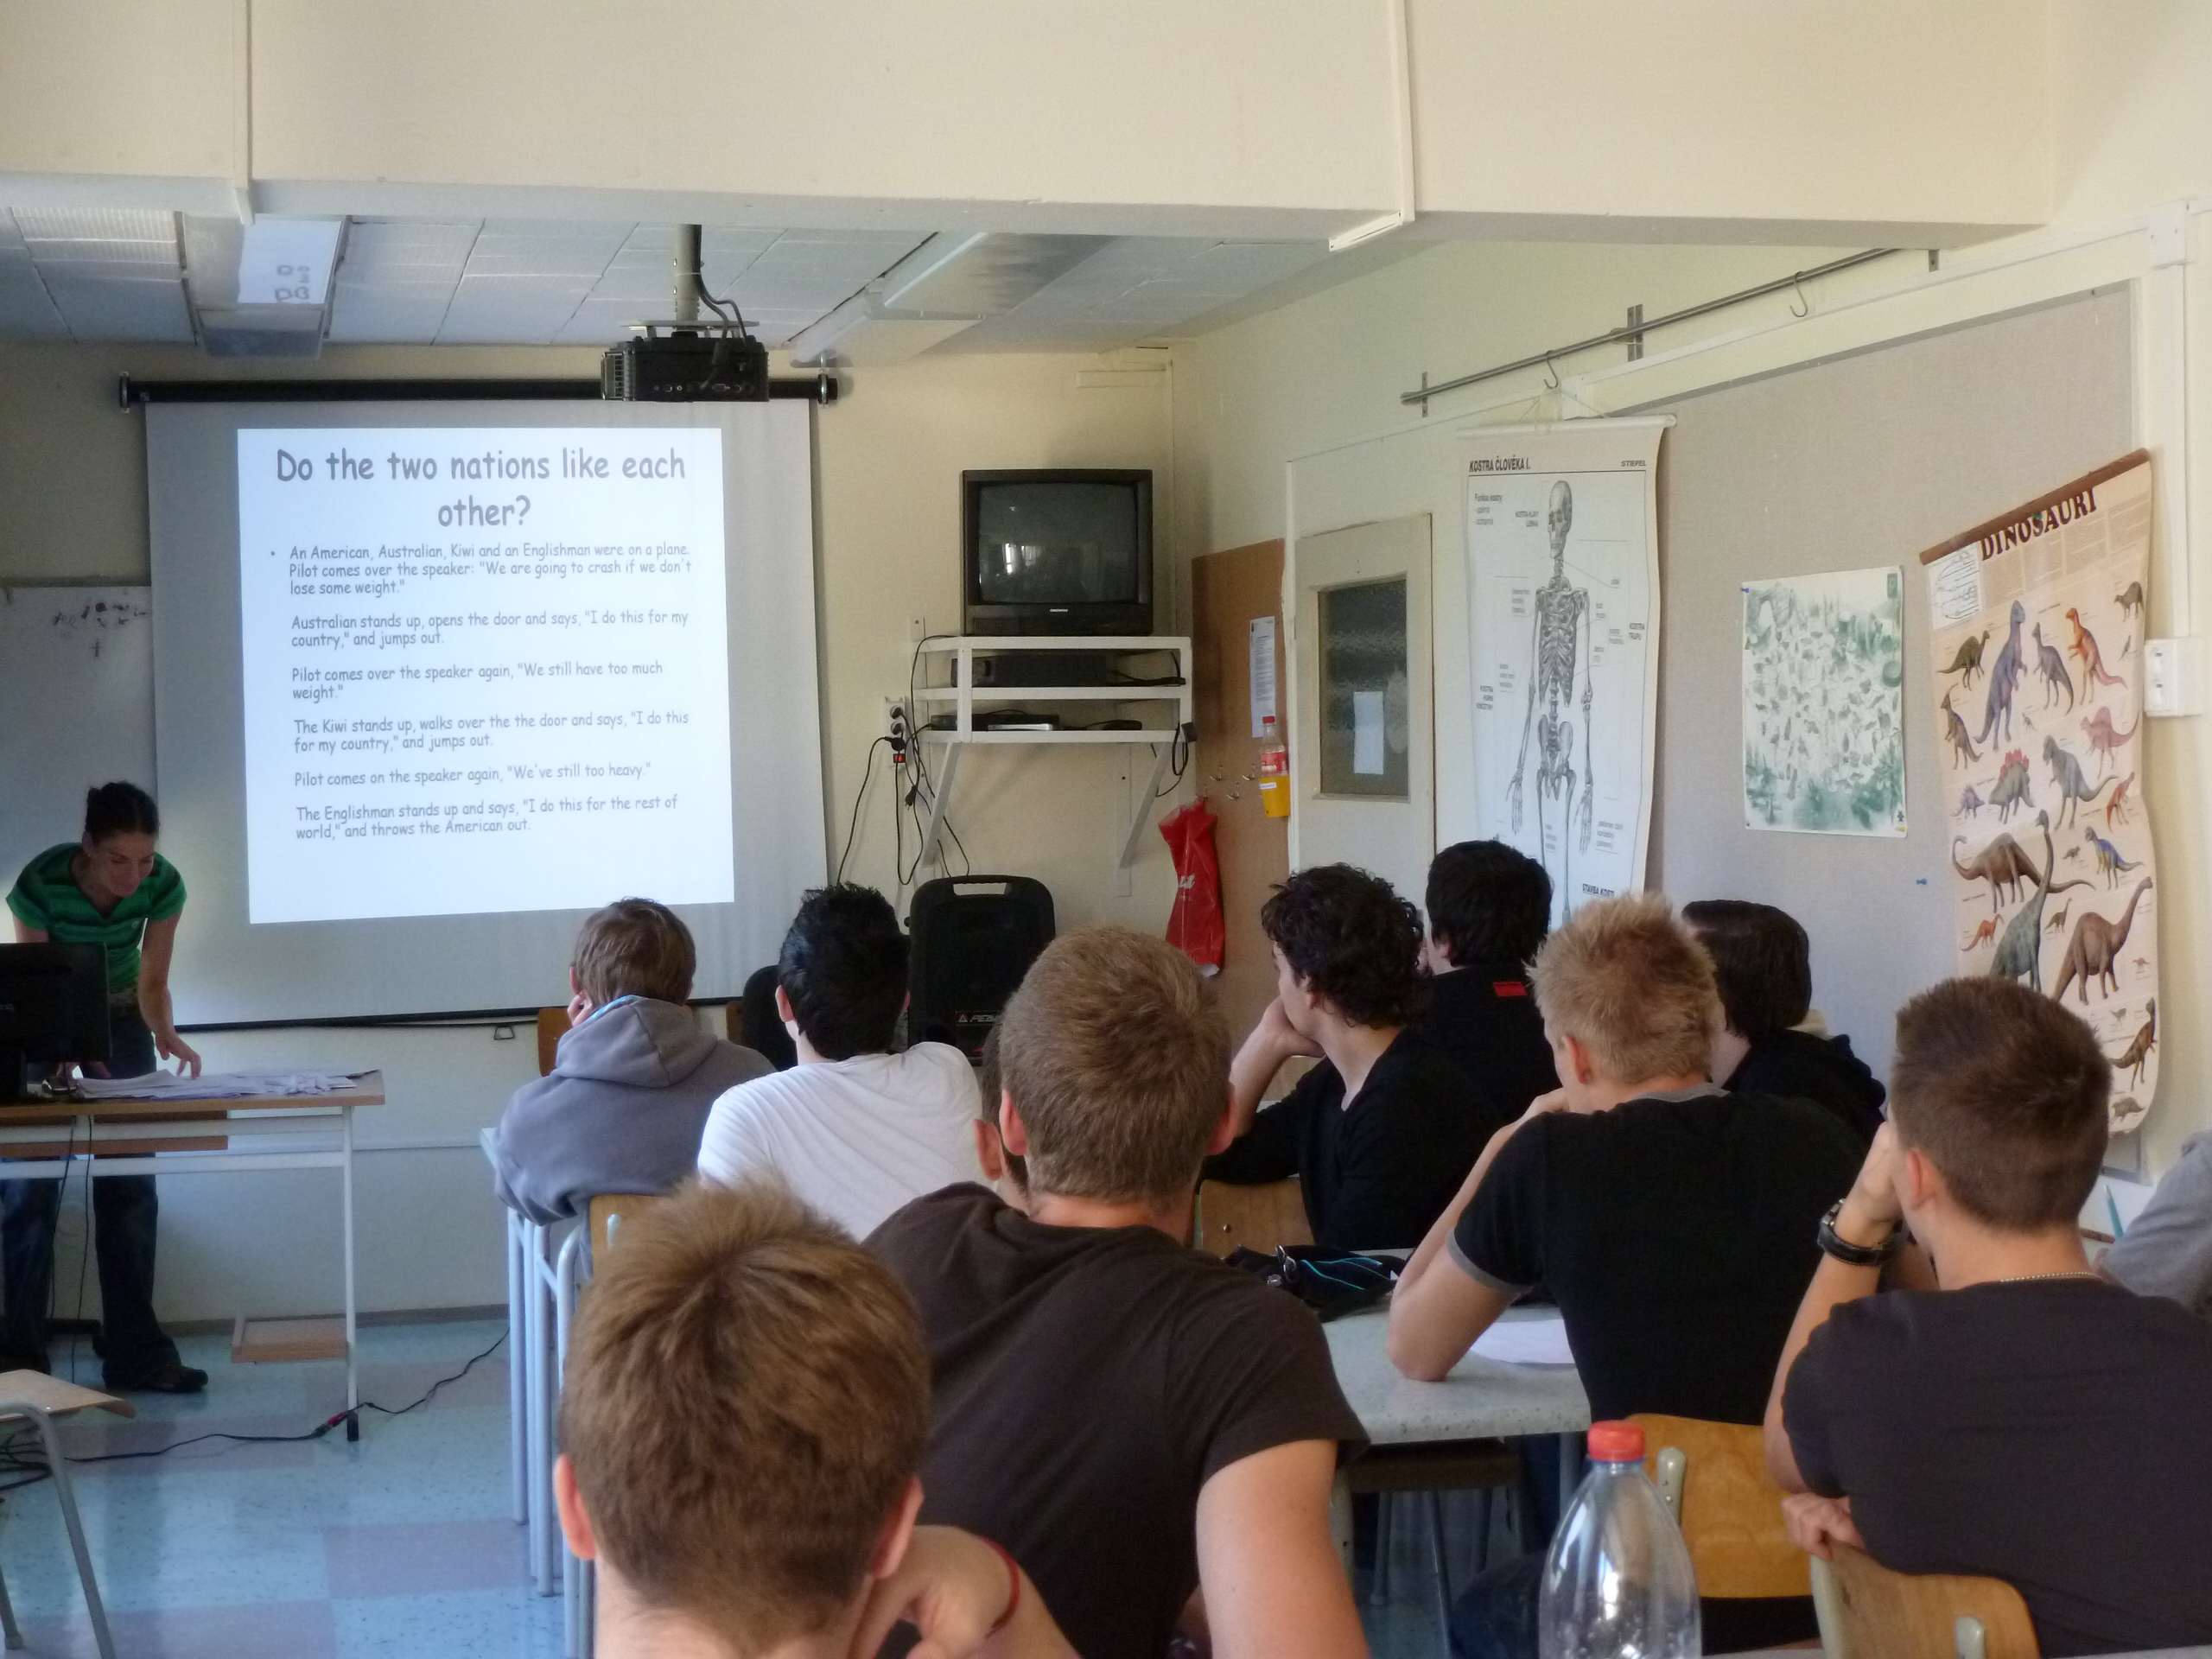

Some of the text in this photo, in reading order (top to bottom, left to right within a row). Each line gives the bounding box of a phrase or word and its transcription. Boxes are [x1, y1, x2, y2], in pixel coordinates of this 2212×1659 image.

[276, 447, 685, 482] Do the two nations like each
[1469, 459, 1494, 473] KOSTRA
[1495, 454, 1525, 472] ČLOVĚKA
[438, 494, 531, 527] other?
[289, 545, 307, 560] An
[310, 545, 373, 561] American,
[378, 543, 447, 560] Australian,
[451, 543, 474, 557] Kiwi
[479, 543, 500, 556] and
[505, 547, 518, 556] an
[524, 542, 590, 562] Englishman
[594, 546, 624, 556] were
[628, 546, 642, 556] on
[645, 546, 652, 556] a
[289, 558, 691, 580] Pilot comes over the speaker: "We are going to crash if we don't
[290, 578, 404, 598] lose some weight."
[291, 609, 688, 632] Australian stands up, opens the door and says, "I do this for my
[291, 632, 349, 651] country,"
[353, 630, 375, 645] and
[379, 632, 416, 650] jumps
[292, 660, 663, 683] Pilot comes over the speaker again, "We still have too much
[293, 683, 343, 704] weight."
[294, 710, 689, 735] The Kiwi stands up, walks over the the door and says, "I do this
[294, 737, 315, 753] for
[319, 741, 336, 756] my
[340, 735, 398, 753] country,"
[403, 734, 424, 748] and
[429, 734, 465, 753] jumps
[295, 762, 651, 786] Pilot comes on the speaker again, "We've still too heavy."
[296, 794, 677, 824] The Englishman stands up and says, "I do this for the rest of
[296, 823, 340, 841] world,"
[345, 823, 366, 837] and
[371, 822, 415, 836] throws
[419, 820, 441, 834] the
[445, 819, 503, 833] American
